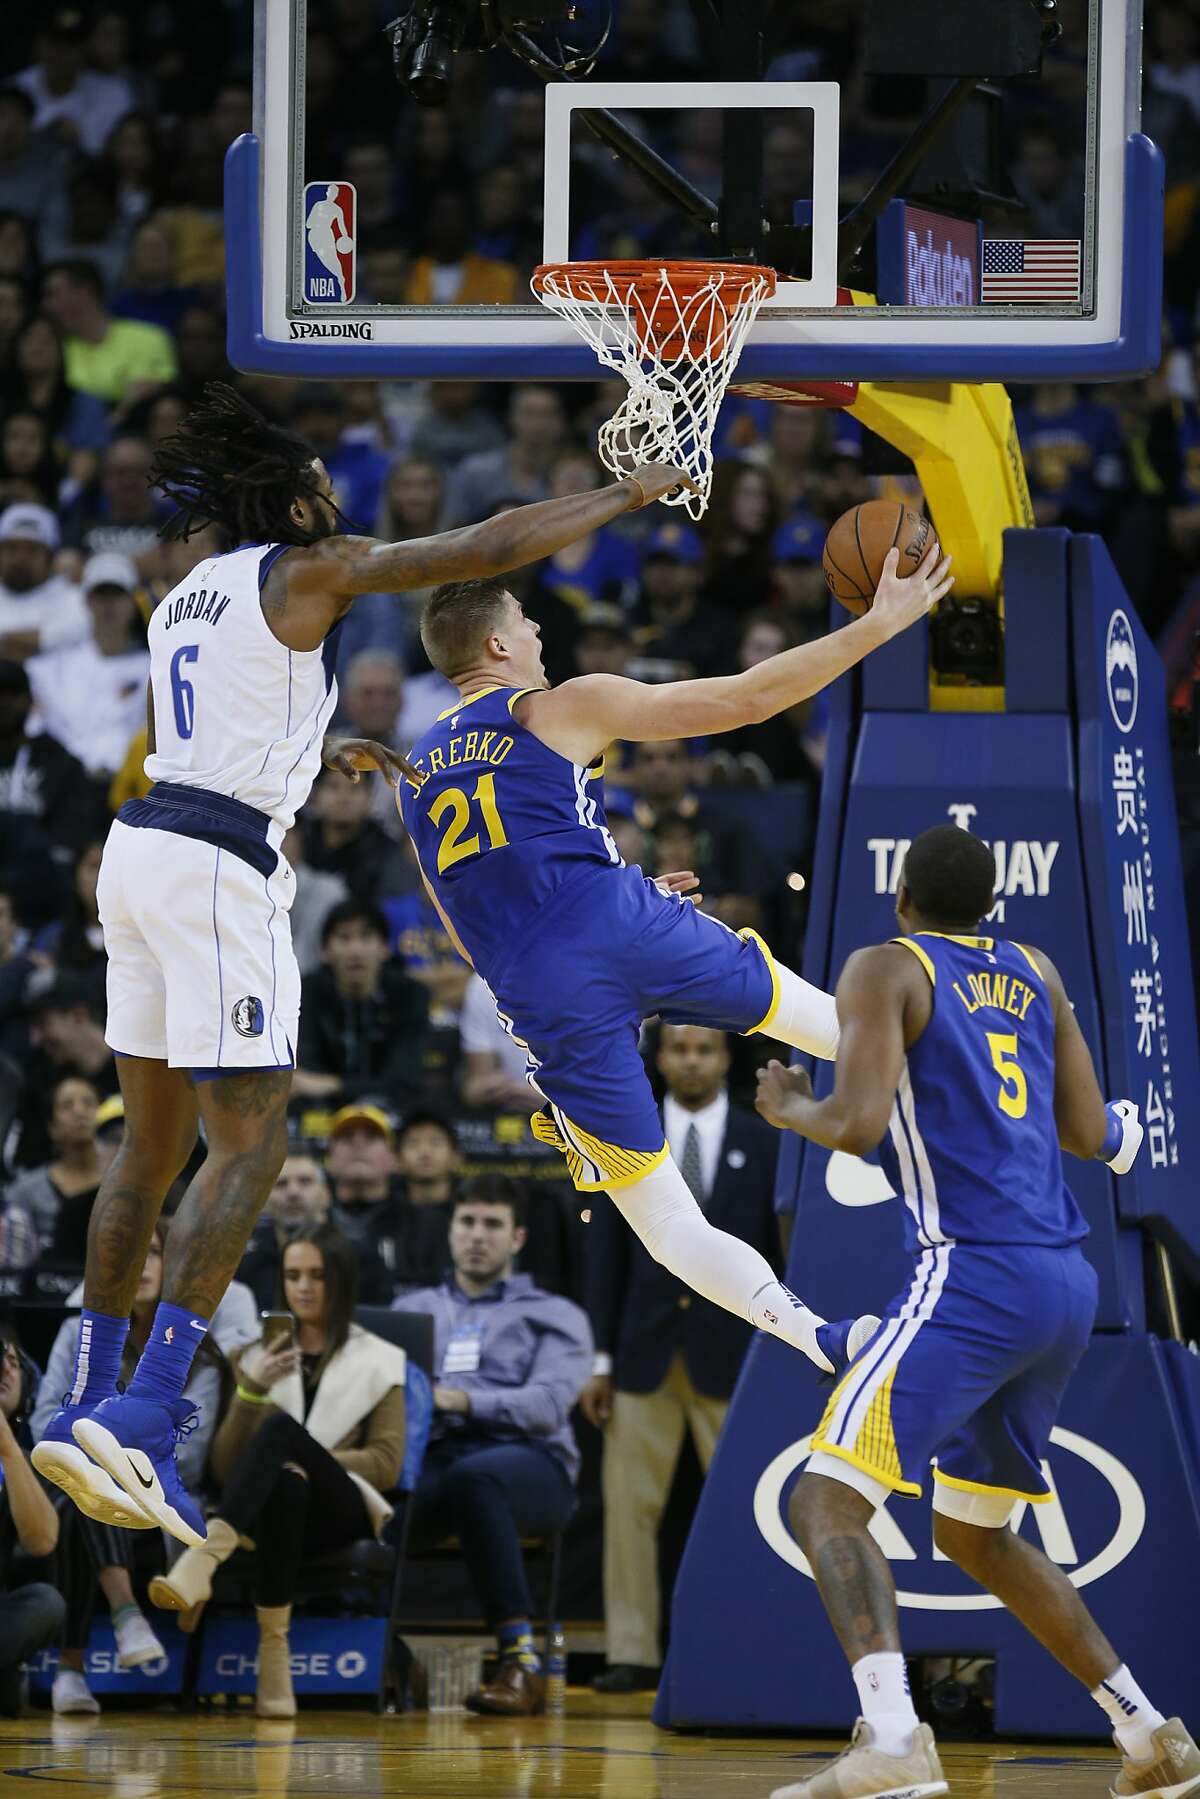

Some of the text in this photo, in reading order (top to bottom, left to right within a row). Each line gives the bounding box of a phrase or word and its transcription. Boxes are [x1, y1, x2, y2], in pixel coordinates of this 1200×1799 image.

[310, 278, 335, 297] NBA
[908, 230, 974, 306] Rakuten
[289, 321, 374, 341] SPALDING
[649, 328, 706, 344] PALDING
[165, 589, 231, 630] JORDAN
[170, 643, 200, 740] 6
[427, 771, 510, 876] 21
[1112, 745, 1169, 1169] 贵州茅台
[953, 972, 1036, 1021] LOONEY
[985, 1031, 1027, 1120] 5
[216, 1654, 331, 1676] CHSE
